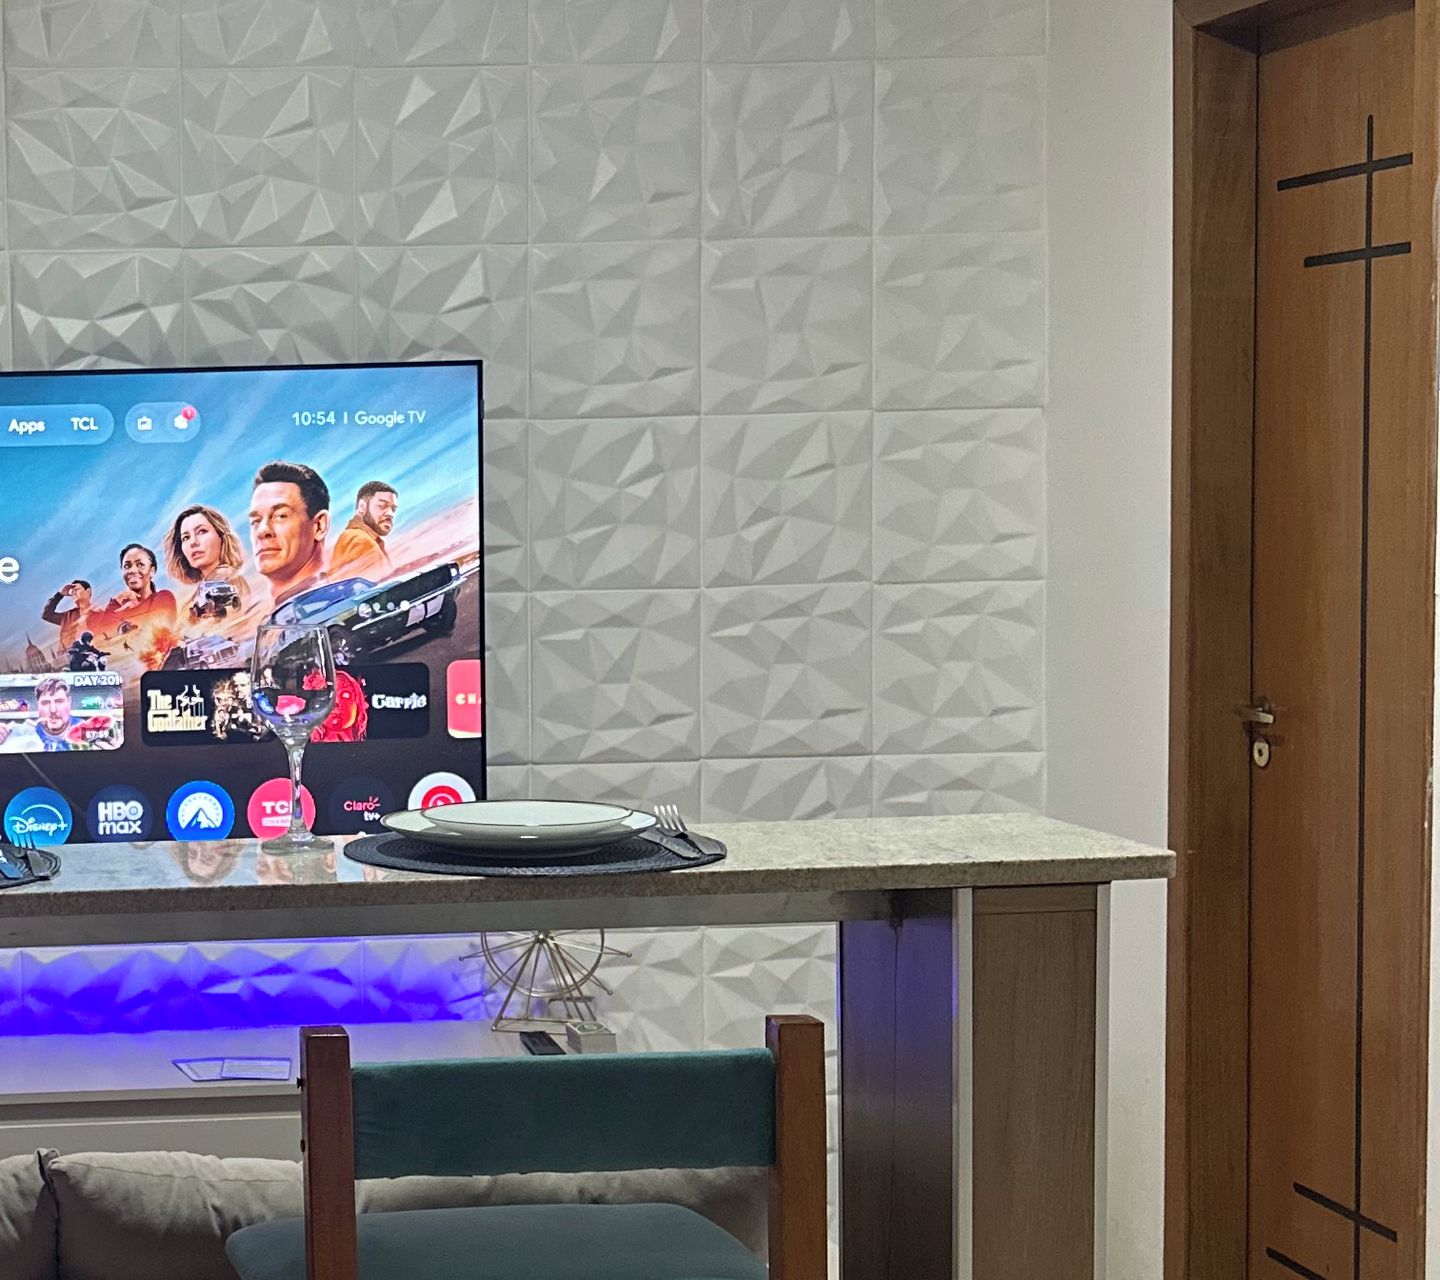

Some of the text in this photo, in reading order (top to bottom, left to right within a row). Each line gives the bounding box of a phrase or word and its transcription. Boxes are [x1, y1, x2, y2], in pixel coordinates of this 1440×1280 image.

[70, 417, 99, 431] TCL
[291, 410, 336, 426] 10:54
[354, 410, 427, 427] Google TV
[8, 418, 46, 435] Apps
[74, 675, 98, 687] DAY
[147, 689, 173, 710] The
[455, 693, 482, 705] CH
[147, 709, 209, 733] Godfather
[97, 800, 143, 822] HBO
[343, 800, 375, 812] Claro
[98, 821, 143, 835] max
